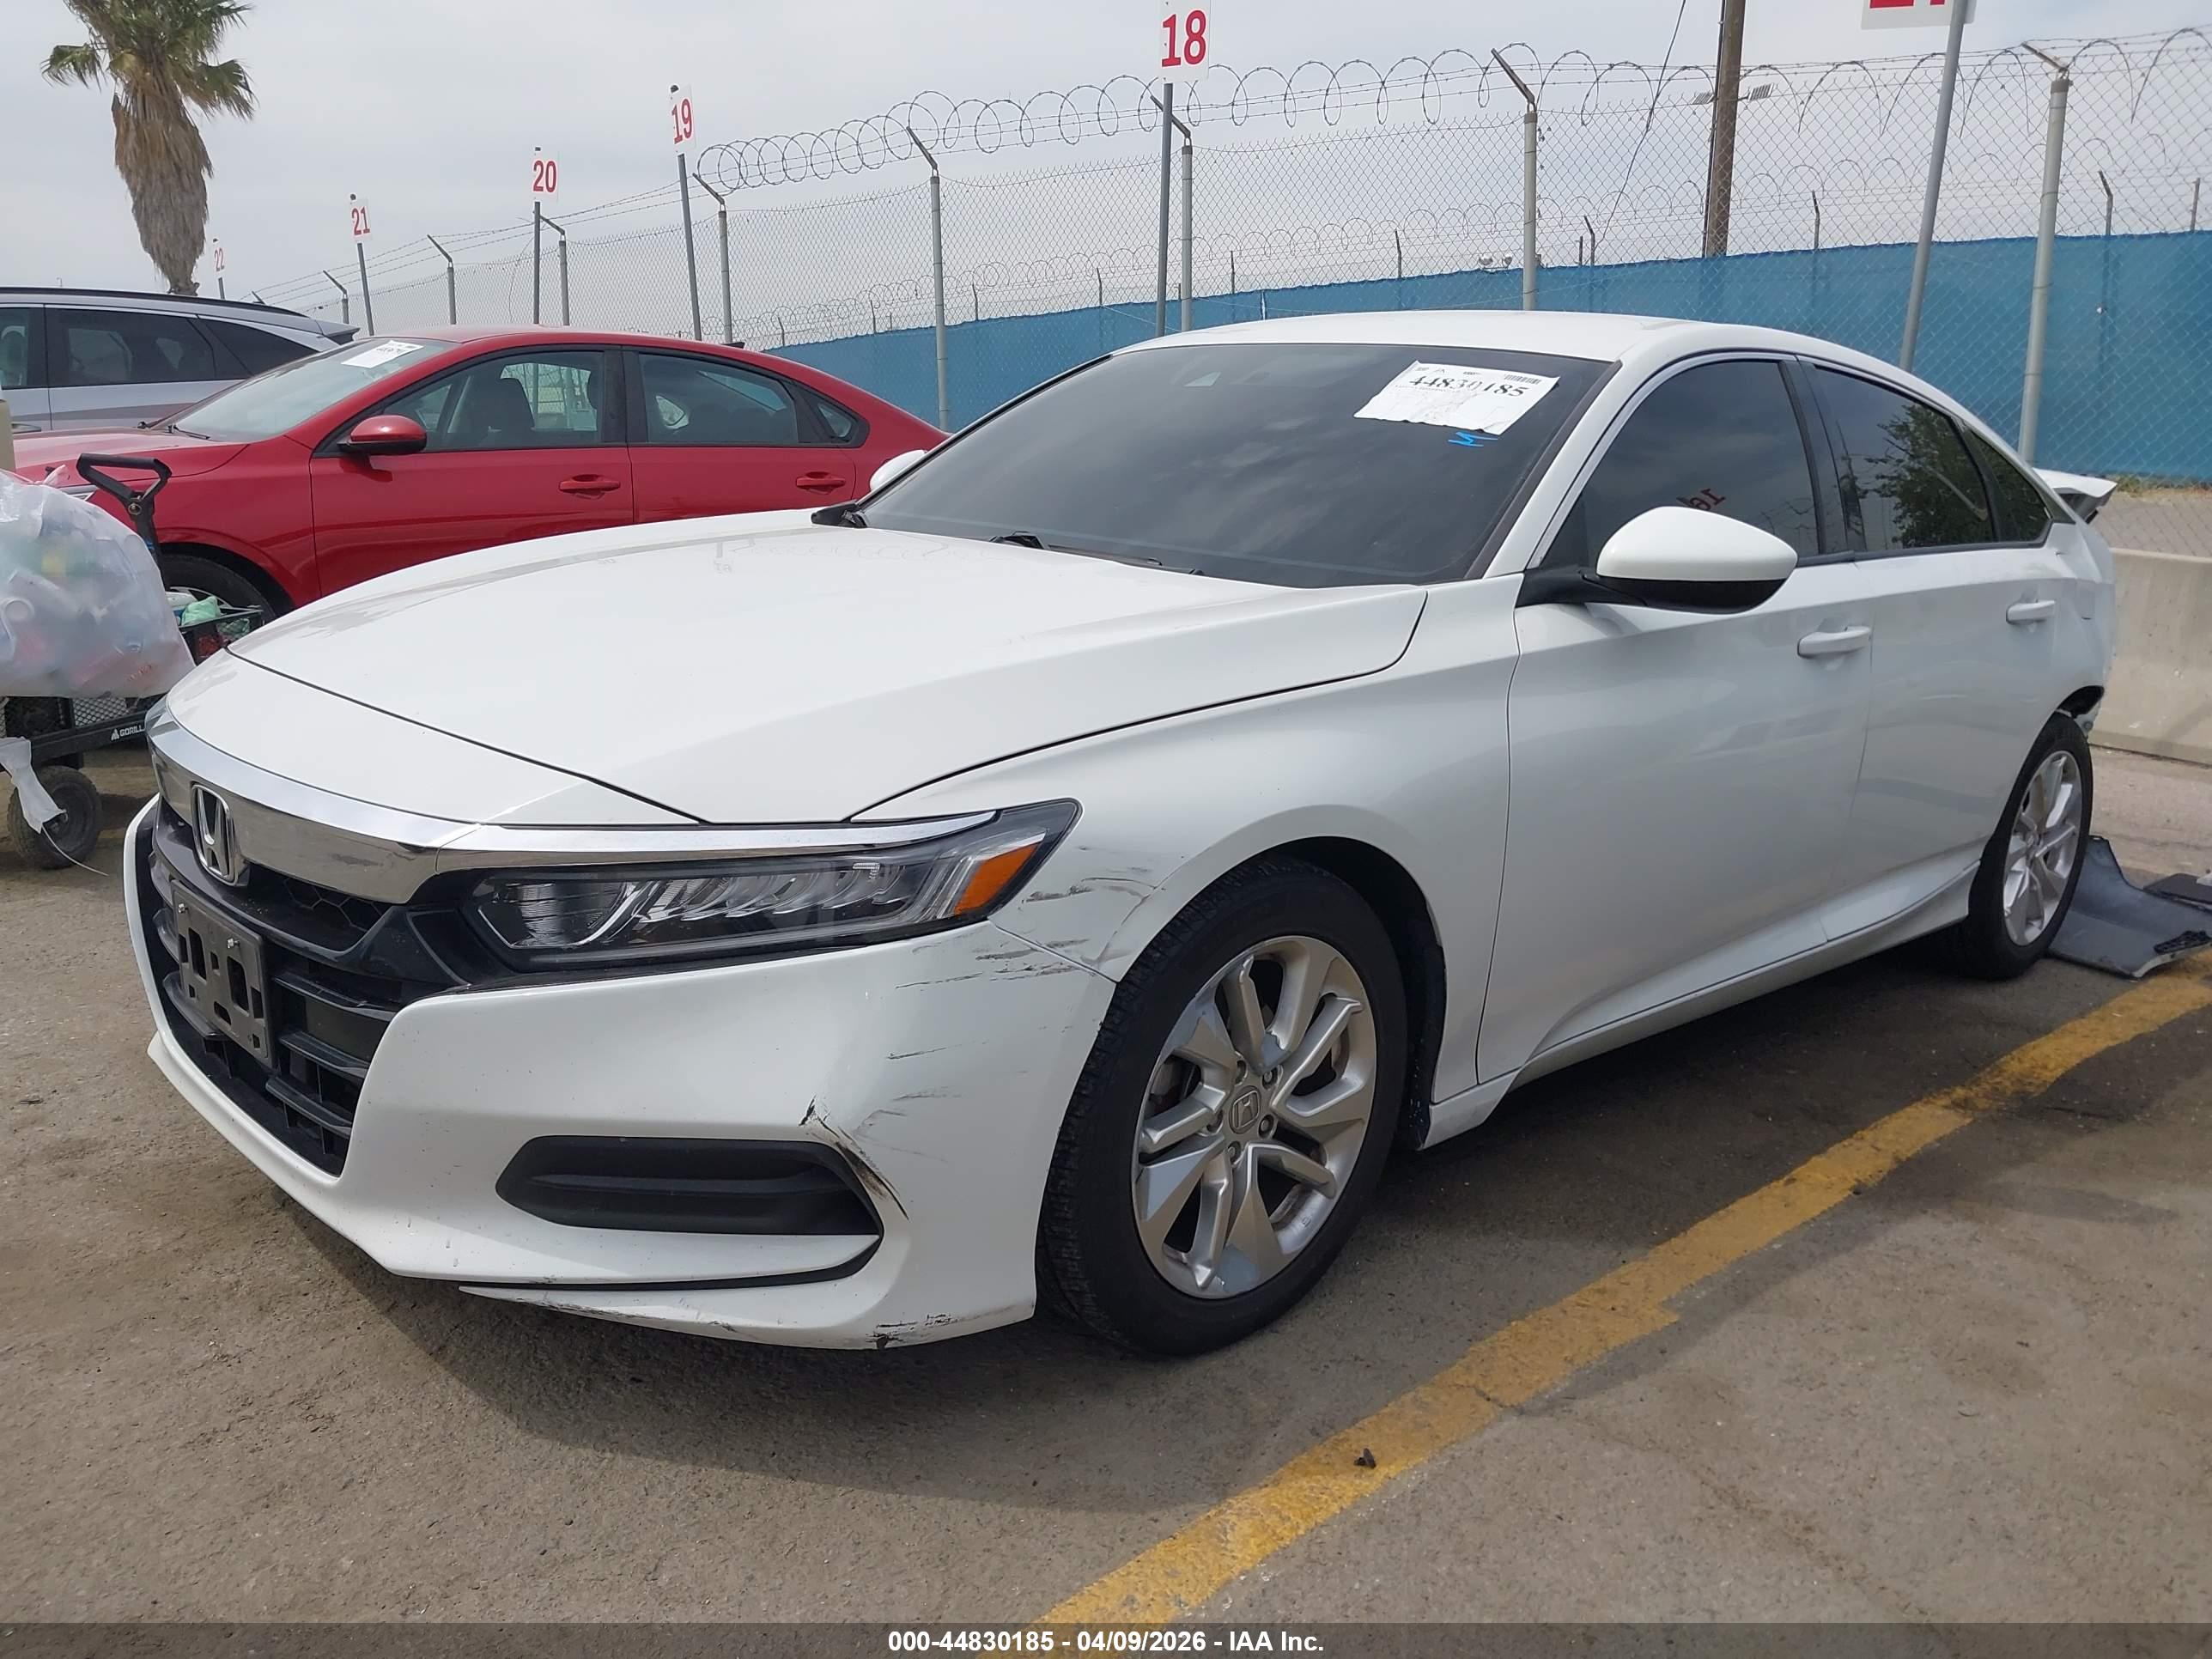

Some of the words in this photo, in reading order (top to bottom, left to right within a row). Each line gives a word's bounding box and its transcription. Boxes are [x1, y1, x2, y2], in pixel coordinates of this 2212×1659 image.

[1162, 9, 1206, 67] 18
[672, 98, 693, 144] 19
[532, 160, 557, 193] 20
[351, 205, 371, 236] 21
[214, 247, 225, 272] 22
[1408, 374, 1529, 397] 44830185
[119, 725, 146, 737] GORILL
